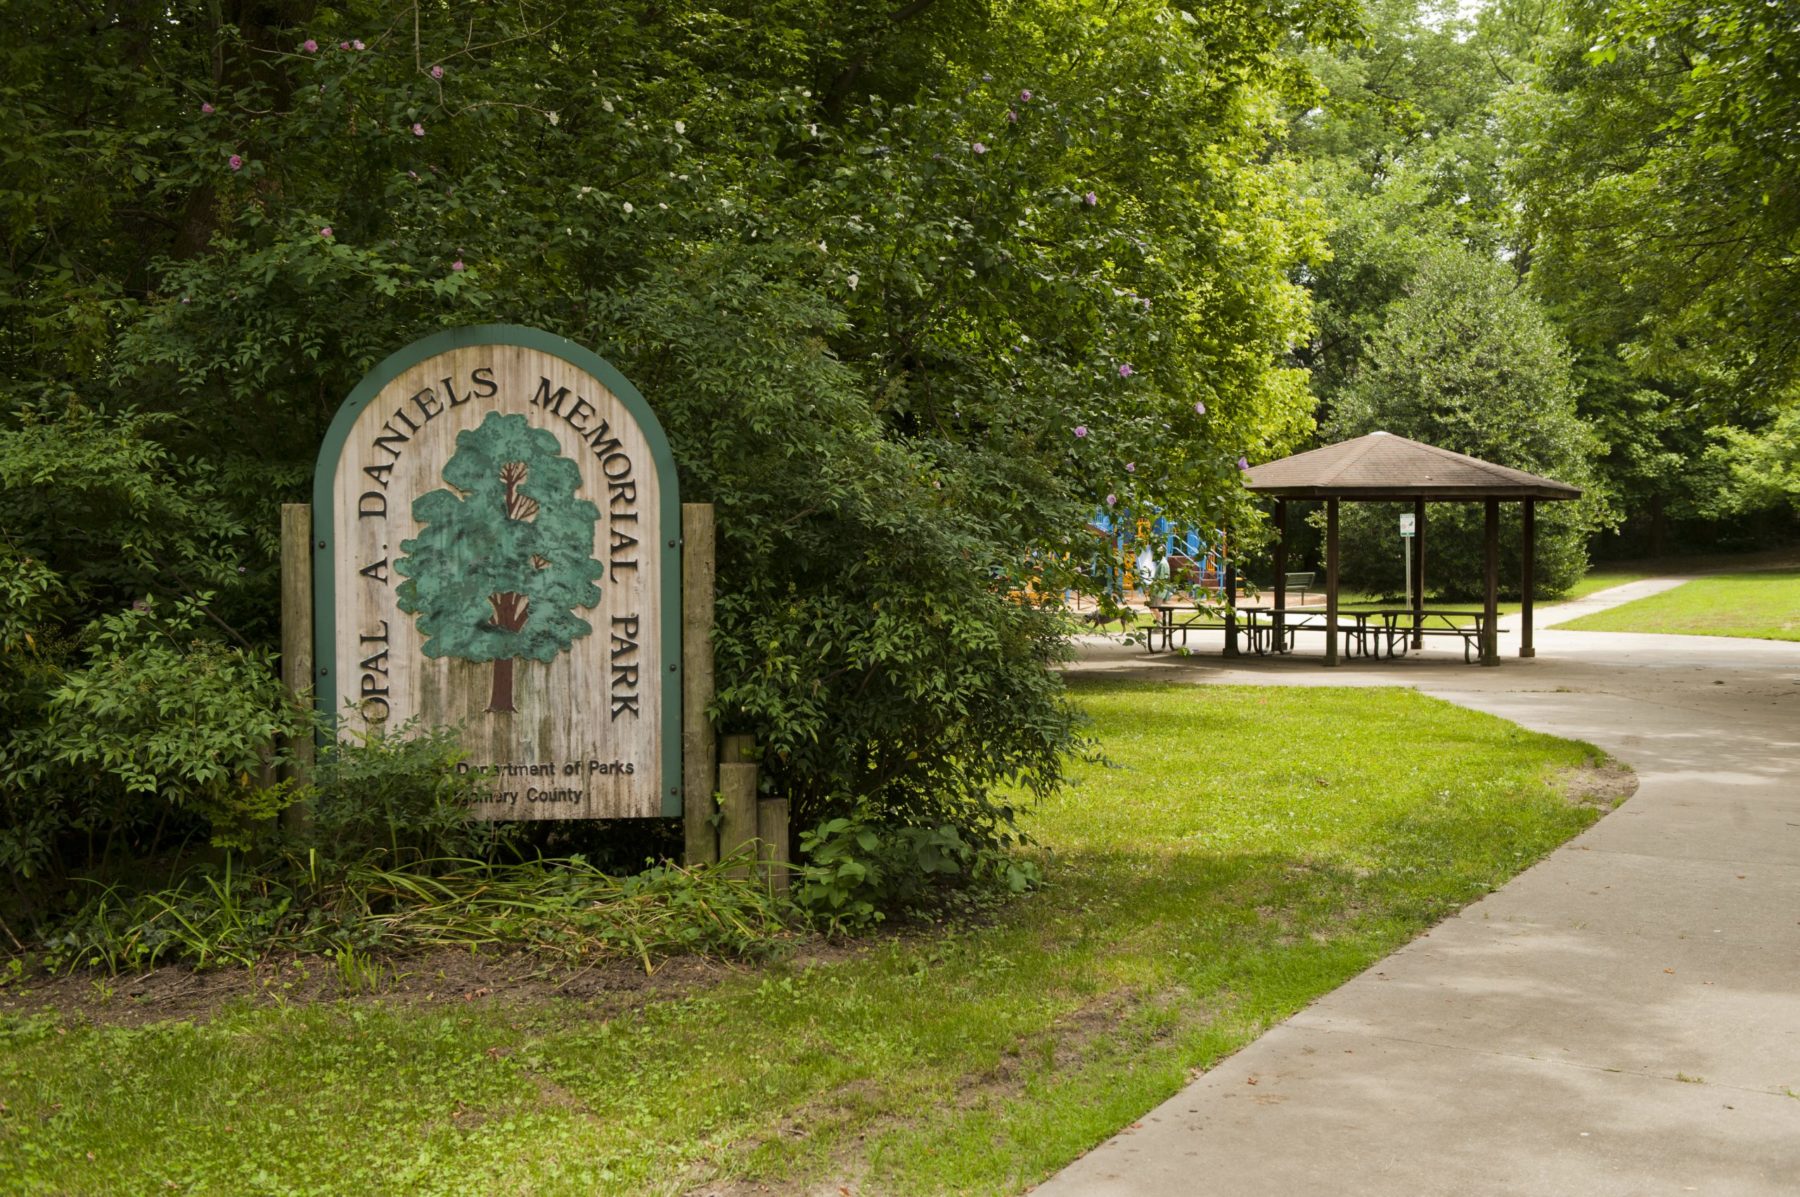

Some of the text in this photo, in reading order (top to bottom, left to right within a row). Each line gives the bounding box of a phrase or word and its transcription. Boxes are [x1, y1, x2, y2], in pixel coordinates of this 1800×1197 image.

[358, 367, 639, 725] OPAL A. DANIELS MEMORIAL PARK
[564, 760, 581, 776] of
[589, 760, 634, 775] Parks
[527, 787, 582, 804] County
